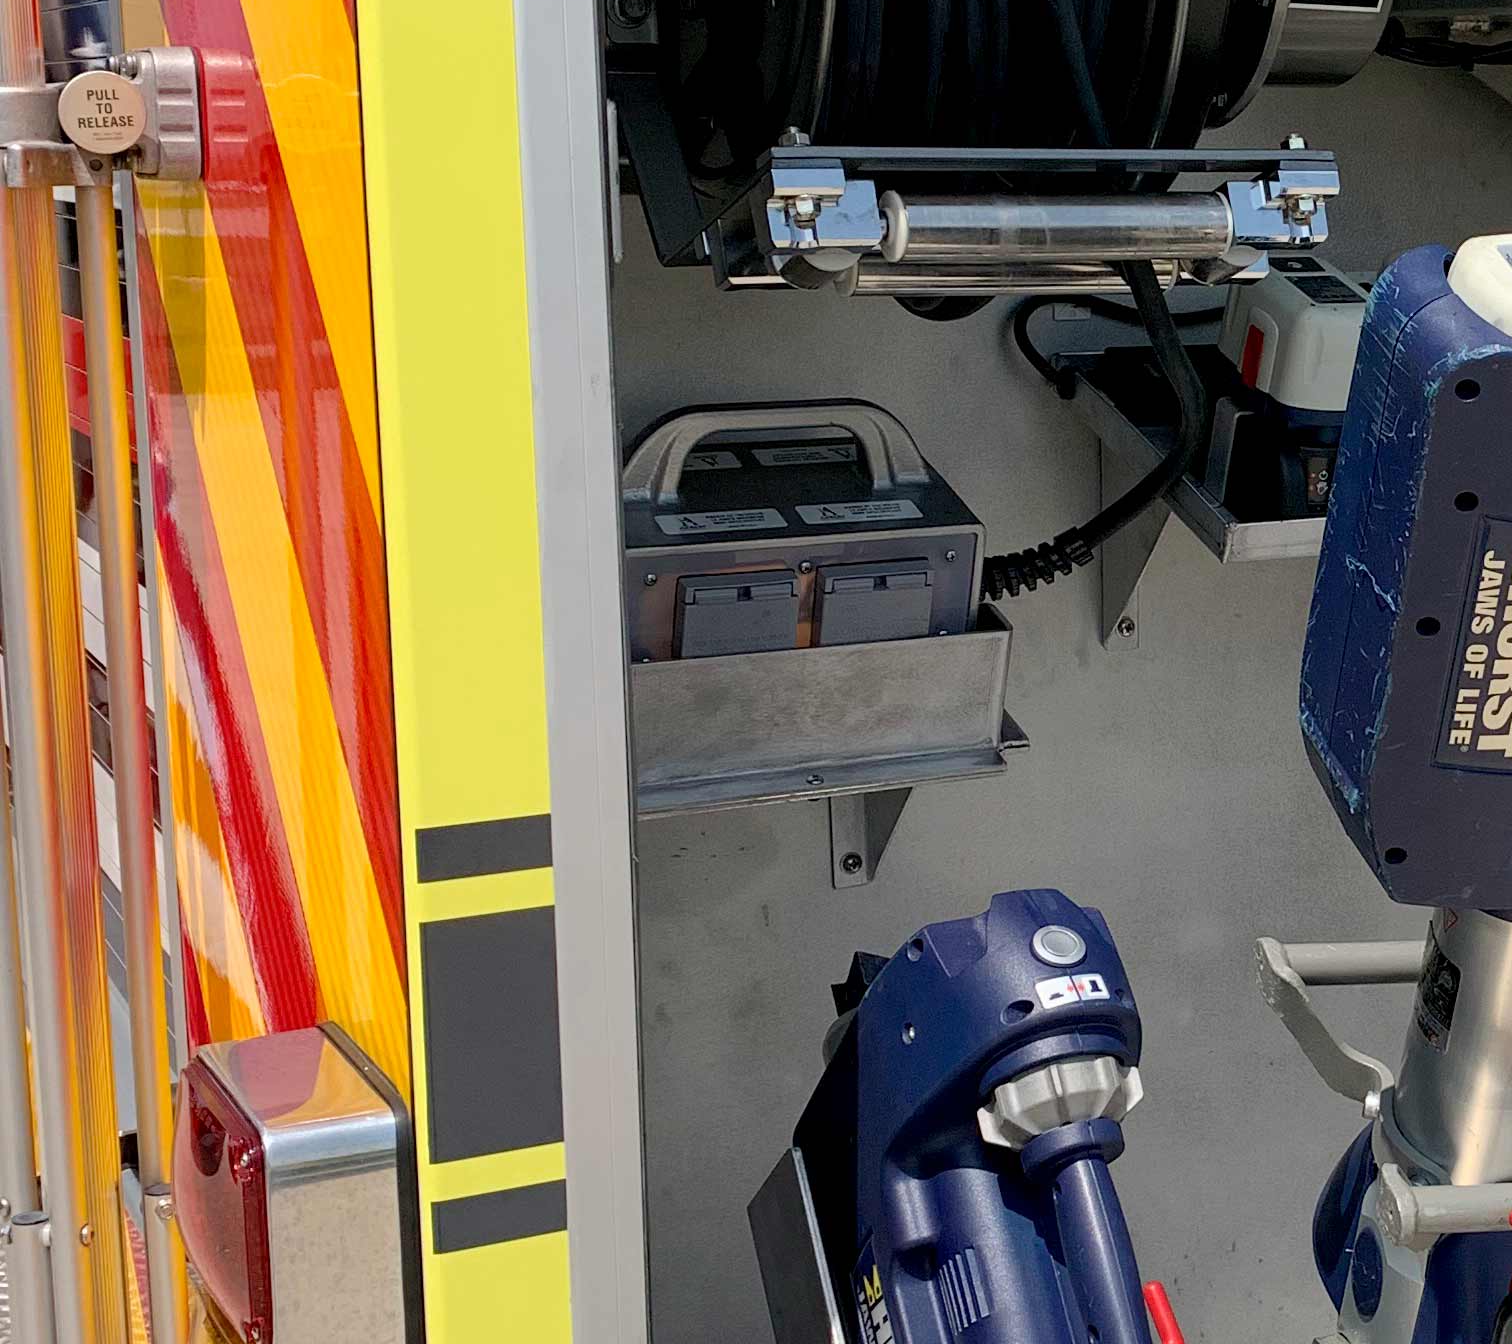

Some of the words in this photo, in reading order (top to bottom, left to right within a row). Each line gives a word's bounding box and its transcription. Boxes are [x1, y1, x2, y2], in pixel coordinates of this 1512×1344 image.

[86, 88, 120, 102] PULL
[96, 102, 113, 114] TO
[77, 114, 135, 129] RELEASE
[1470, 550, 1506, 635] JAWS
[1463, 645, 1489, 678] OF
[1450, 688, 1480, 745] LIFE
